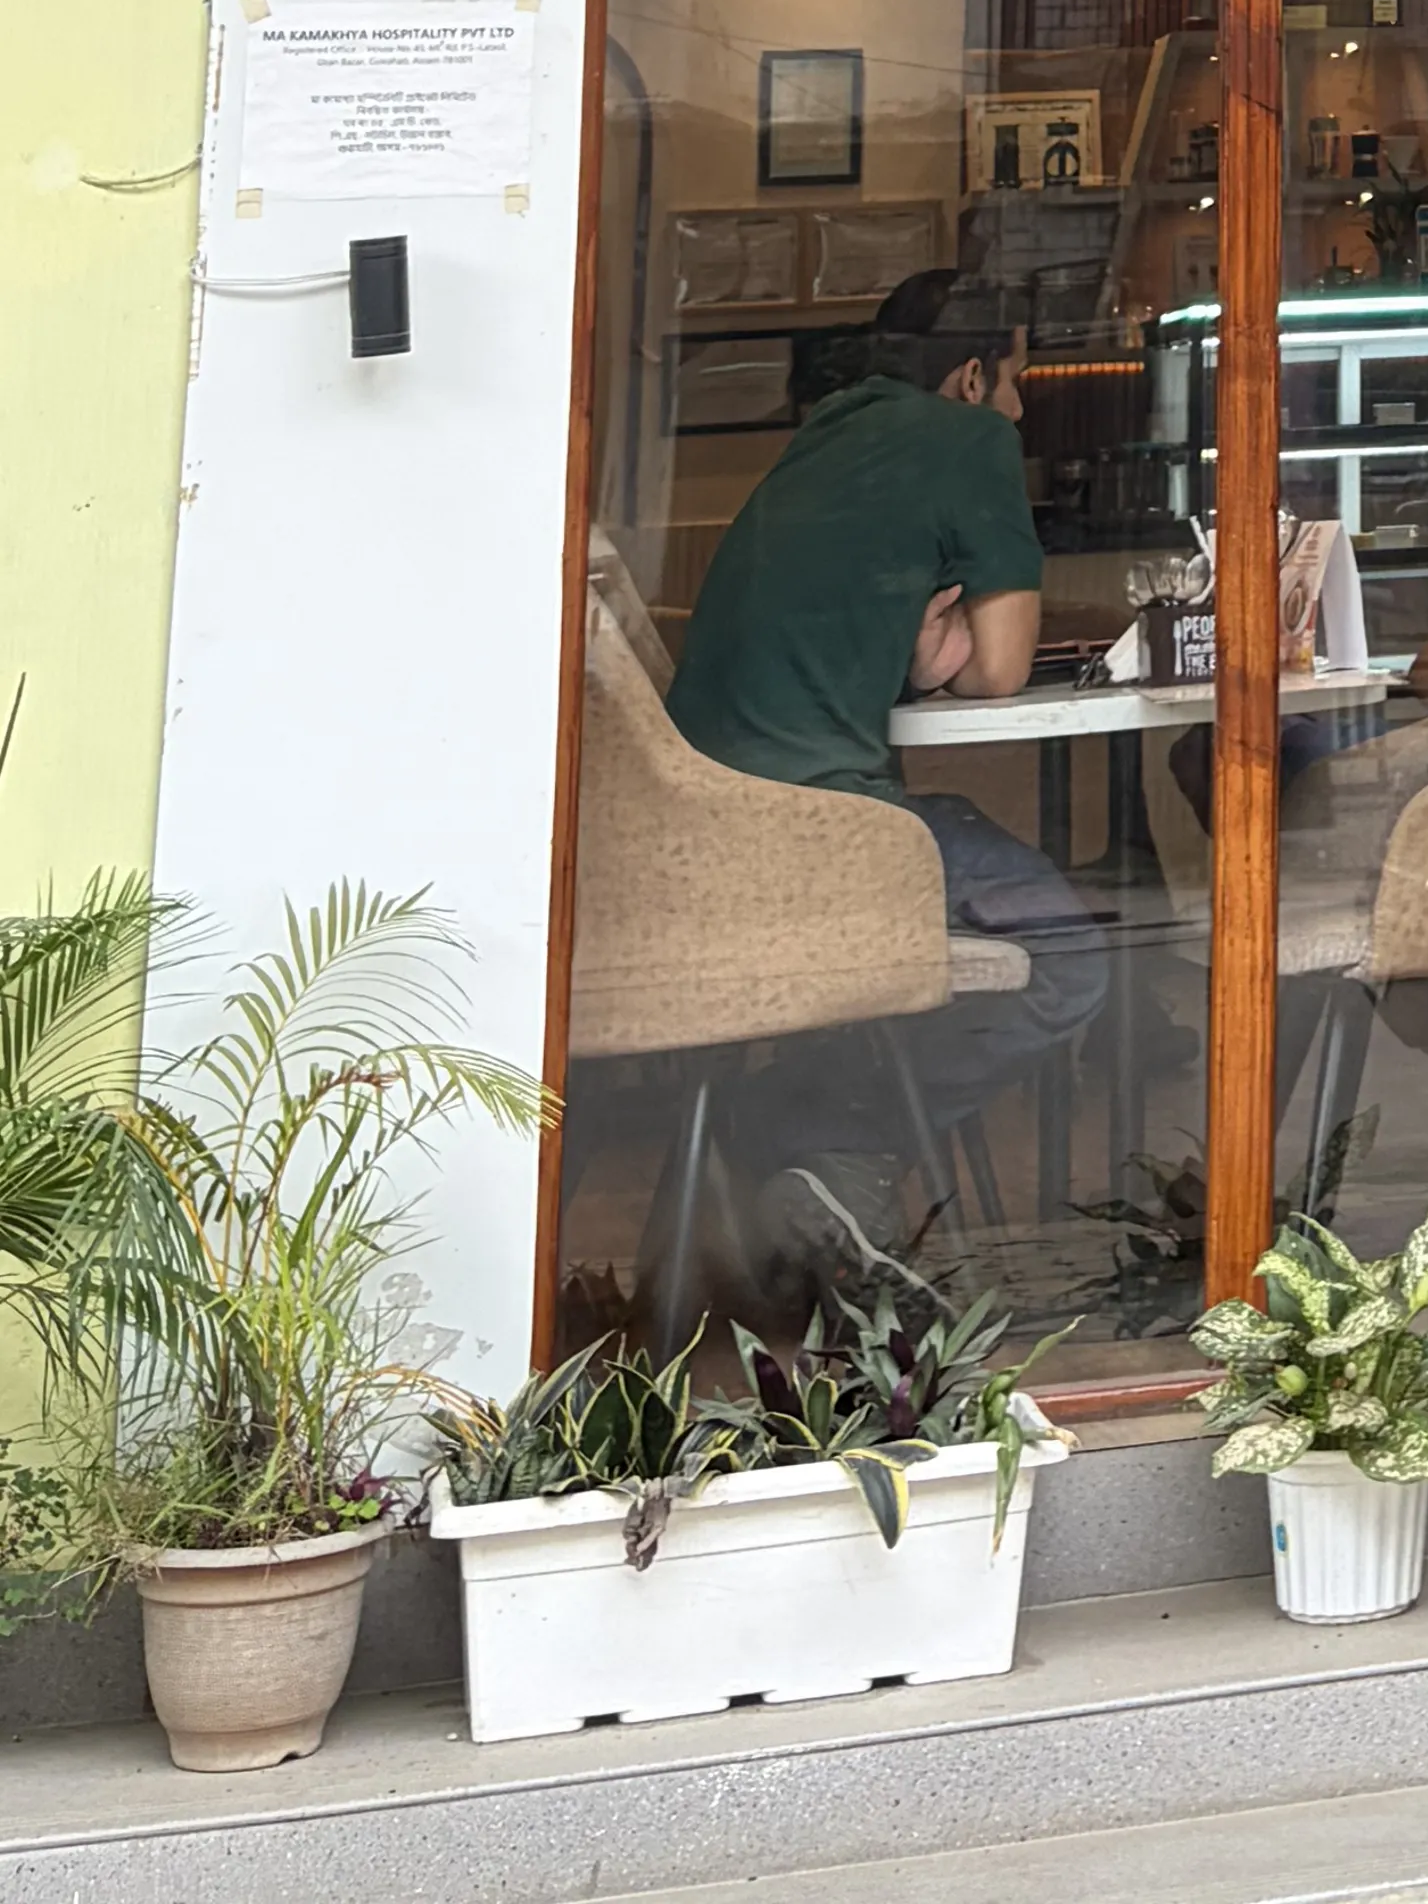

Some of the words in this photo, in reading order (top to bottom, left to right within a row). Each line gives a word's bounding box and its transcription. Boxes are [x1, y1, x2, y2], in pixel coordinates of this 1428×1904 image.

[263, 30, 286, 41] MA
[289, 29, 368, 41] KAMAKHYA
[372, 28, 458, 40] HOSPITALITY
[461, 28, 486, 39] PVT
[490, 27, 515, 38] LTD
